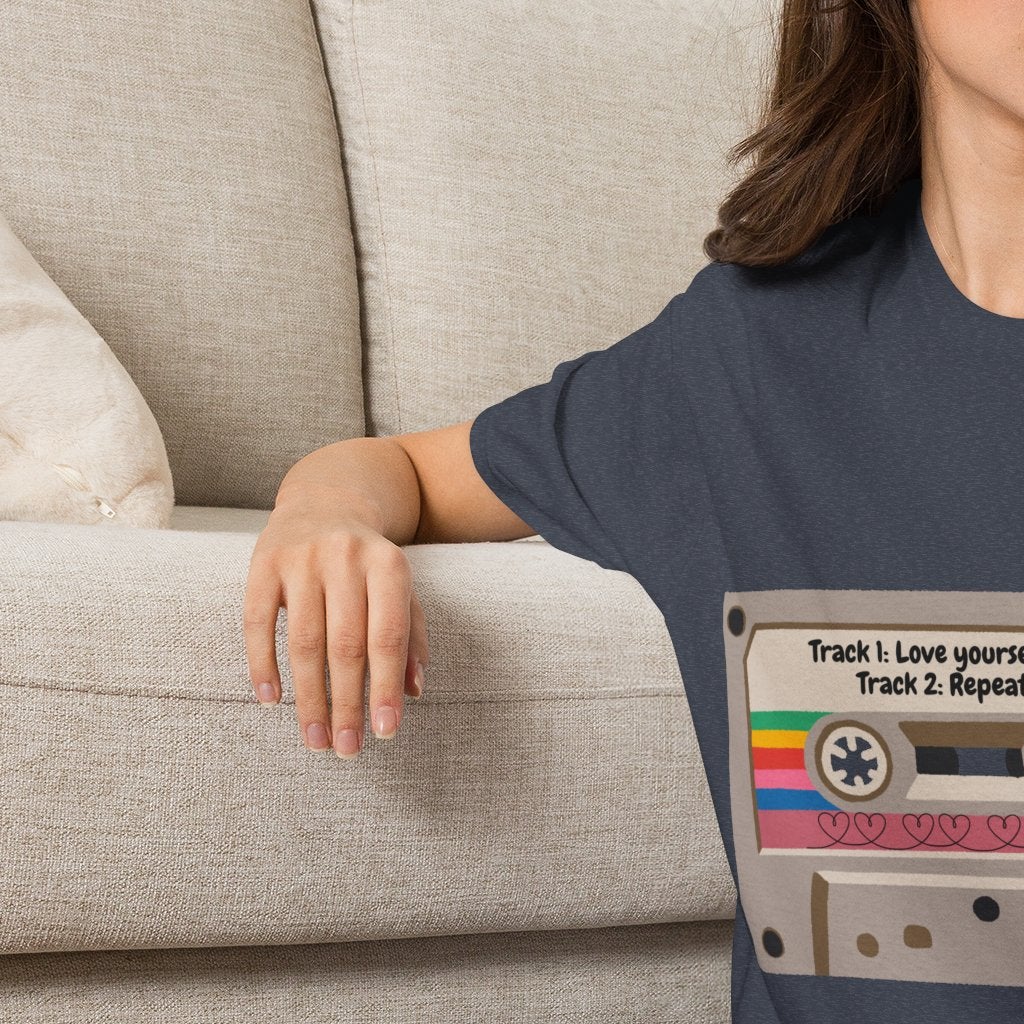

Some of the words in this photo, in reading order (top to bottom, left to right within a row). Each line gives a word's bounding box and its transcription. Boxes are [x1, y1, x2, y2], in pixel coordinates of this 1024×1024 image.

[808, 639, 871, 663] Track
[876, 640, 889, 663] 1:
[896, 640, 947, 664] Love
[856, 671, 917, 695] Track
[924, 672, 943, 695] 2:
